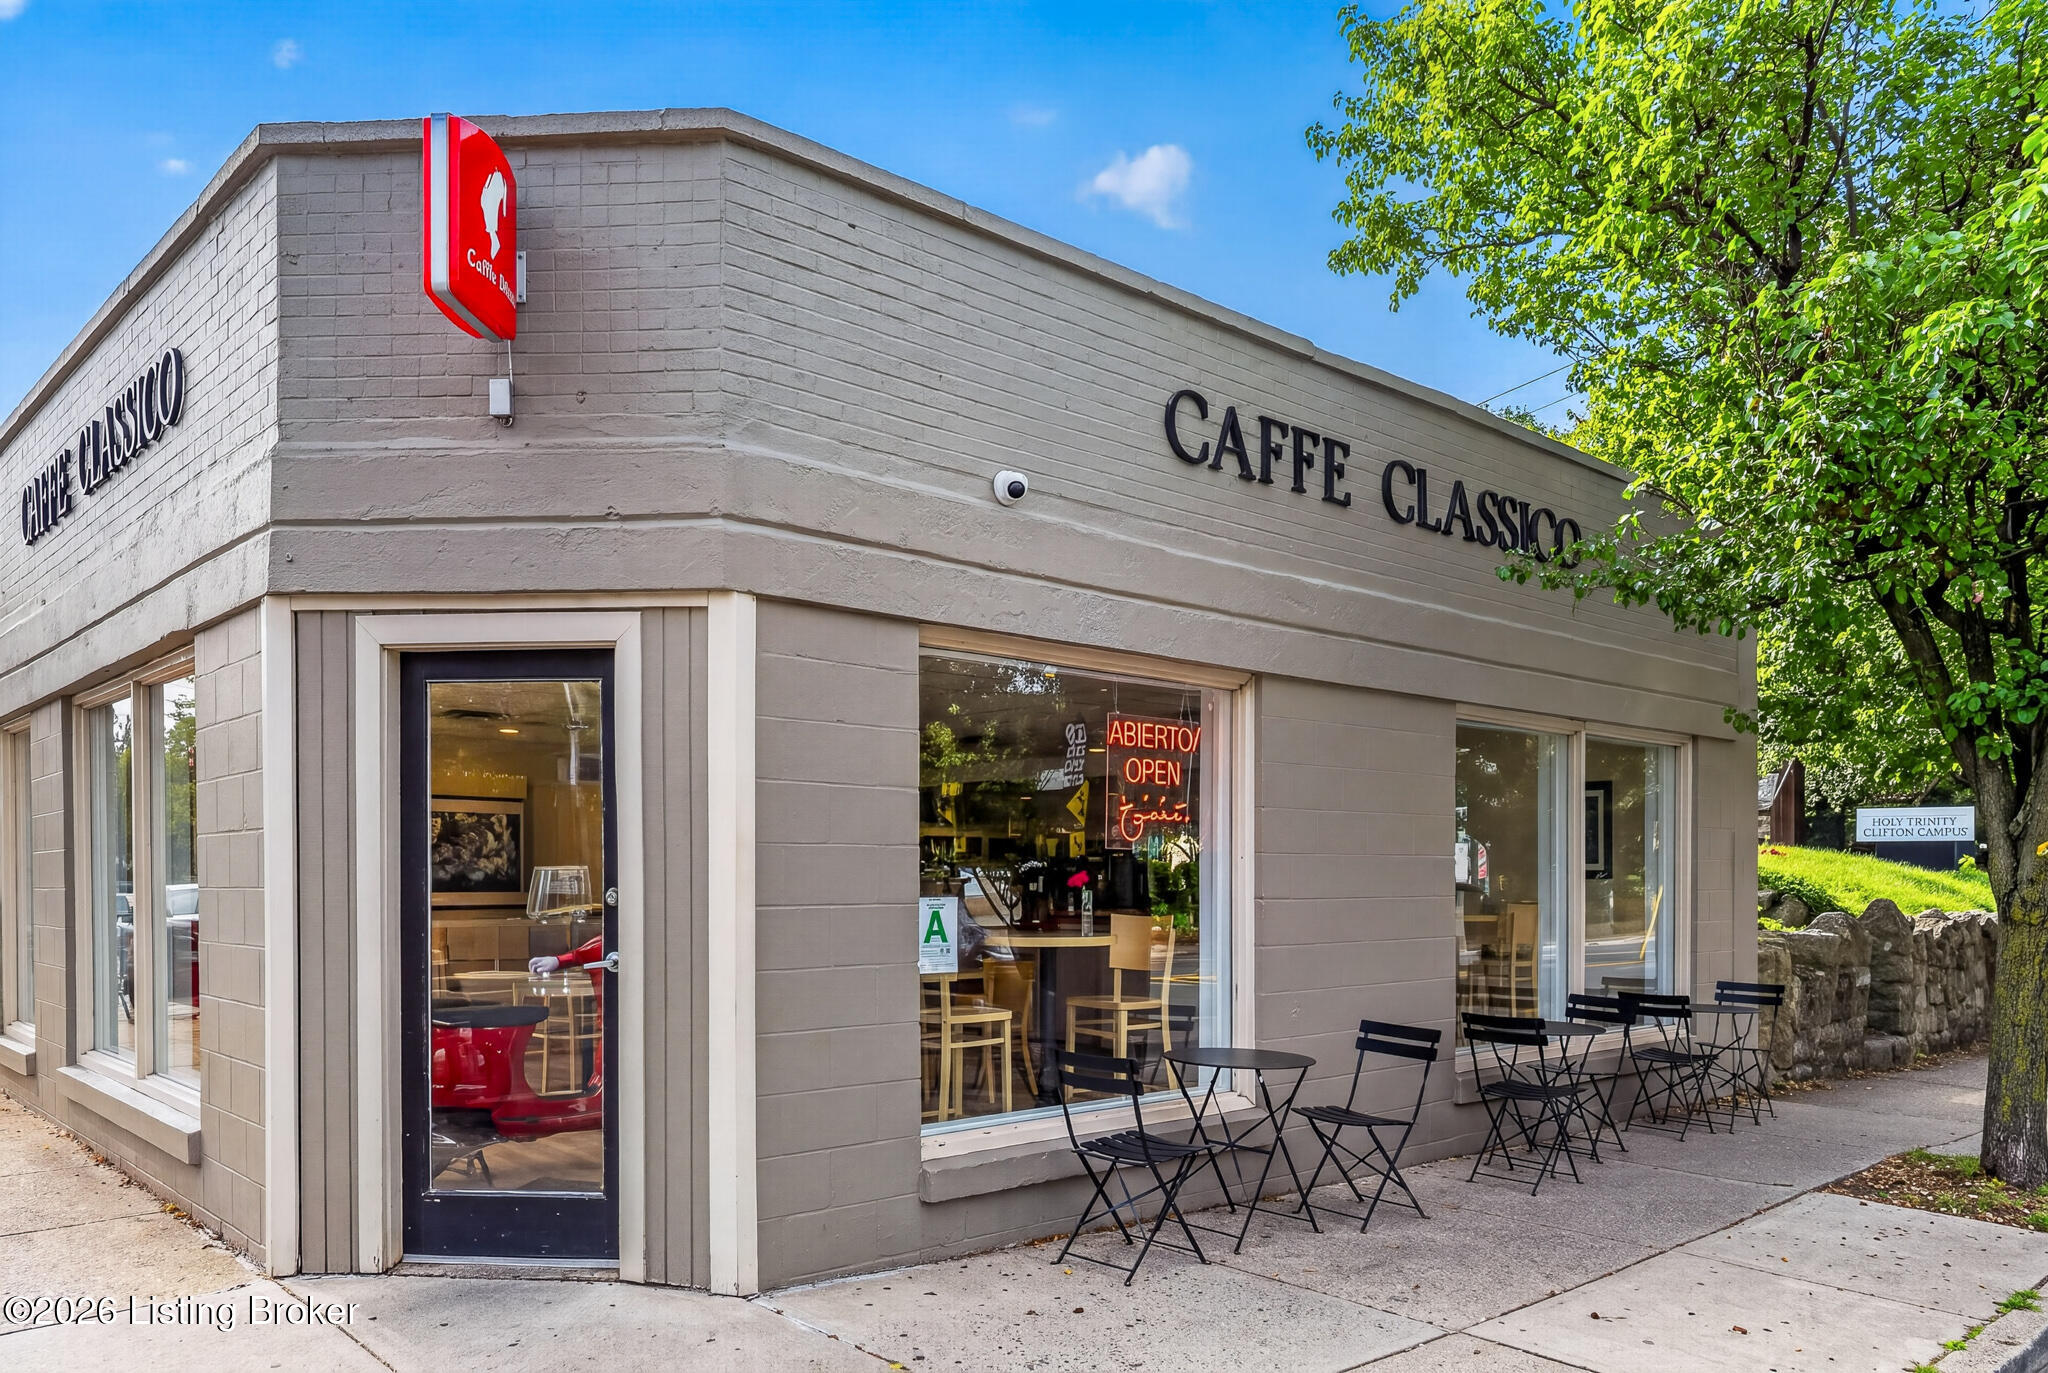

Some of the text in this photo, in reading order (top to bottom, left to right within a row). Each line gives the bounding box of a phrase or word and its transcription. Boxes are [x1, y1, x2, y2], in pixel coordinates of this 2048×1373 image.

[21, 347, 186, 545] CAFFE CLASSICO
[1164, 389, 1582, 570] CAFFE CLASSICO
[1108, 720, 1201, 753] ABIERTO/
[1125, 757, 1181, 786] OPEN
[1863, 827, 1969, 837] CLIFTON CAMPUS
[1872, 816, 1958, 827] HOLY TRINITY
[924, 911, 948, 943] A
